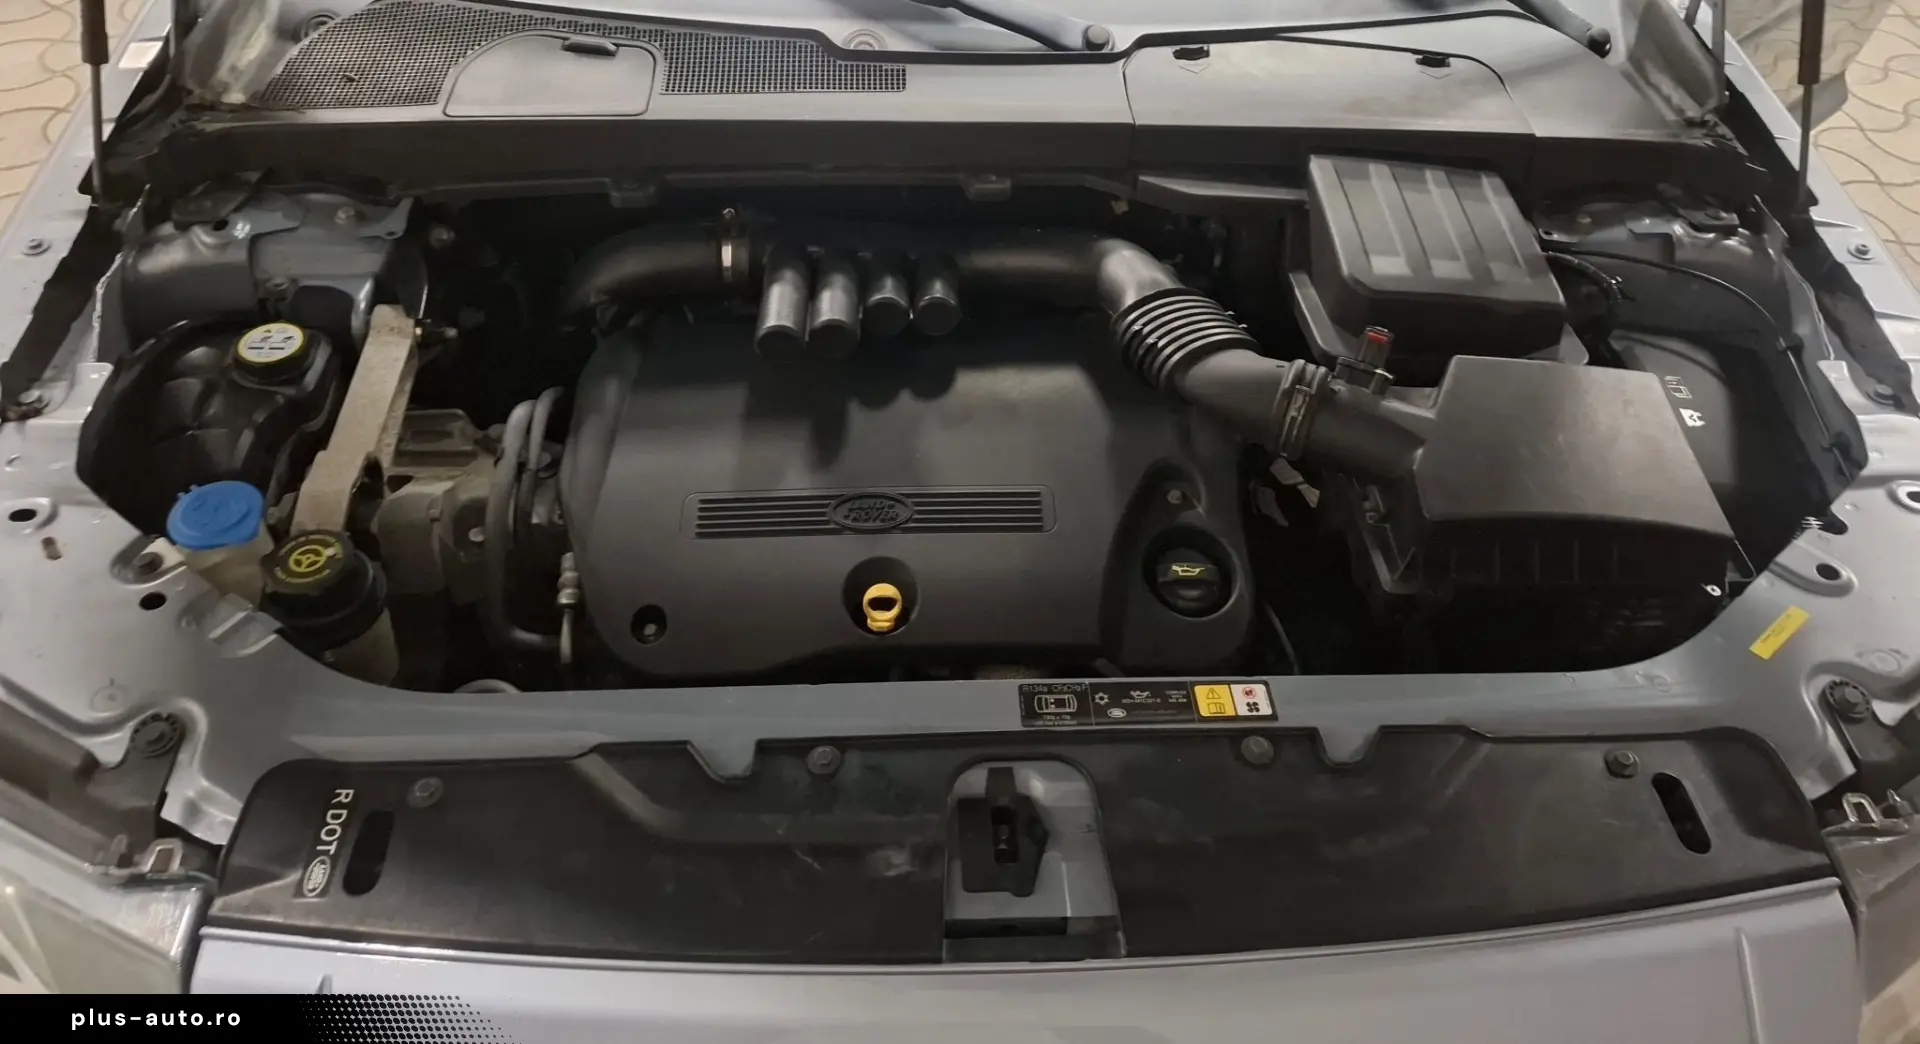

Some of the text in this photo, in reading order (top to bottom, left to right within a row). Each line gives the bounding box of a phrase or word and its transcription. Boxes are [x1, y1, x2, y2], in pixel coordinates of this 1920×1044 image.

[848, 509, 899, 522] ROVER
[316, 789, 354, 855] R DOT
